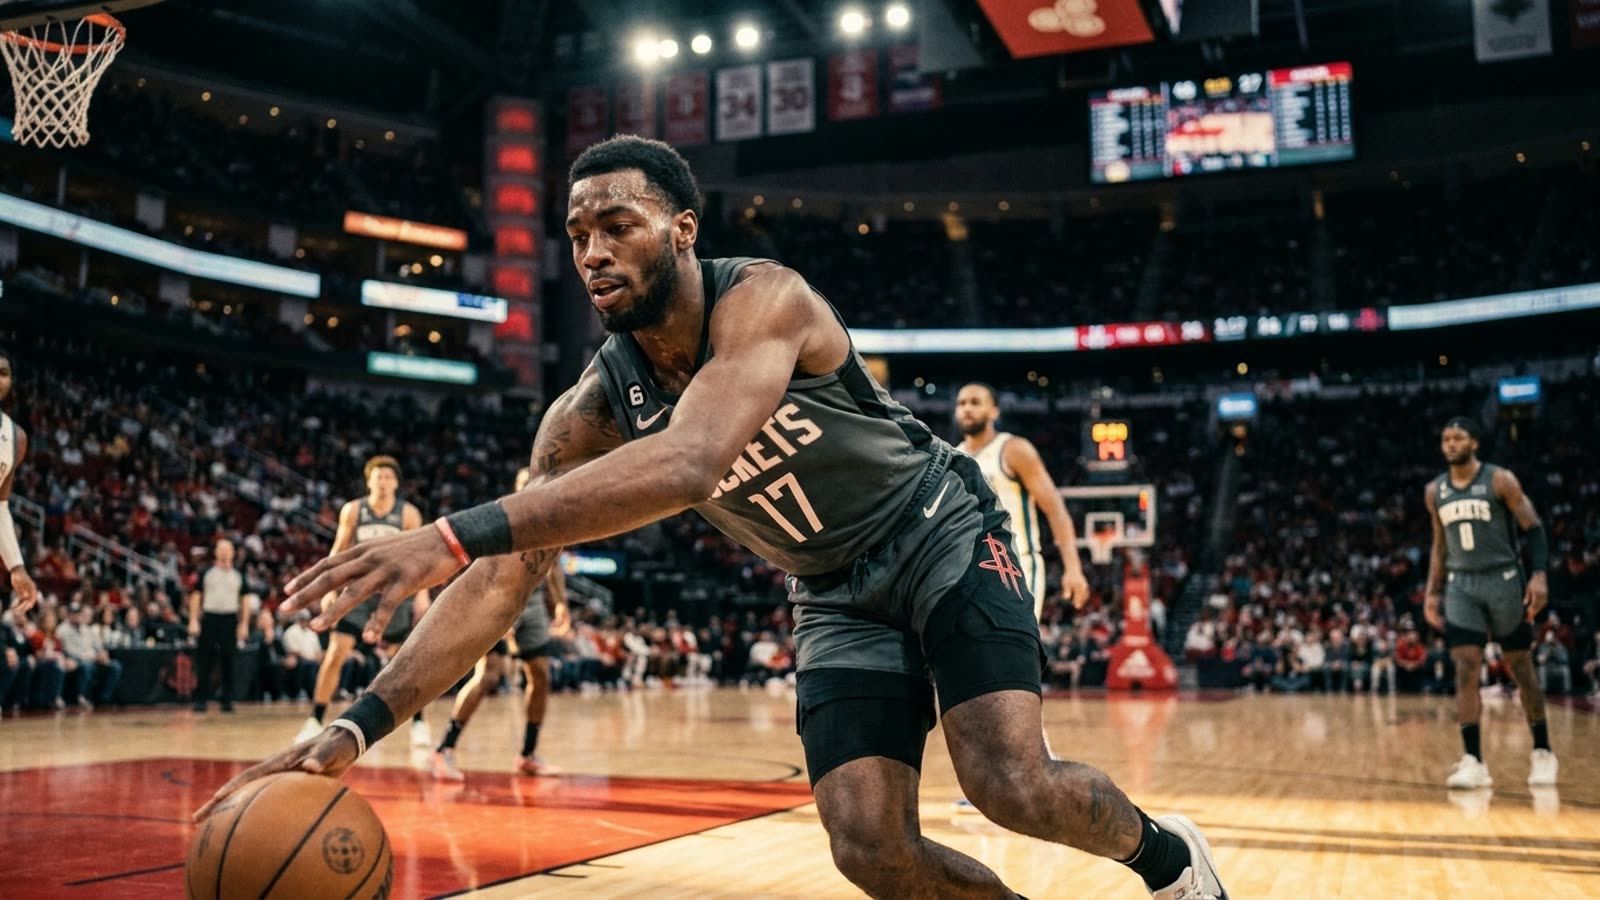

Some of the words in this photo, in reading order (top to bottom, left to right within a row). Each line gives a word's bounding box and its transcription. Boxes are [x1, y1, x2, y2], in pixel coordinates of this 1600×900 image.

[629, 385, 644, 406] 6
[707, 402, 824, 501] KETS
[747, 471, 825, 544] 17
